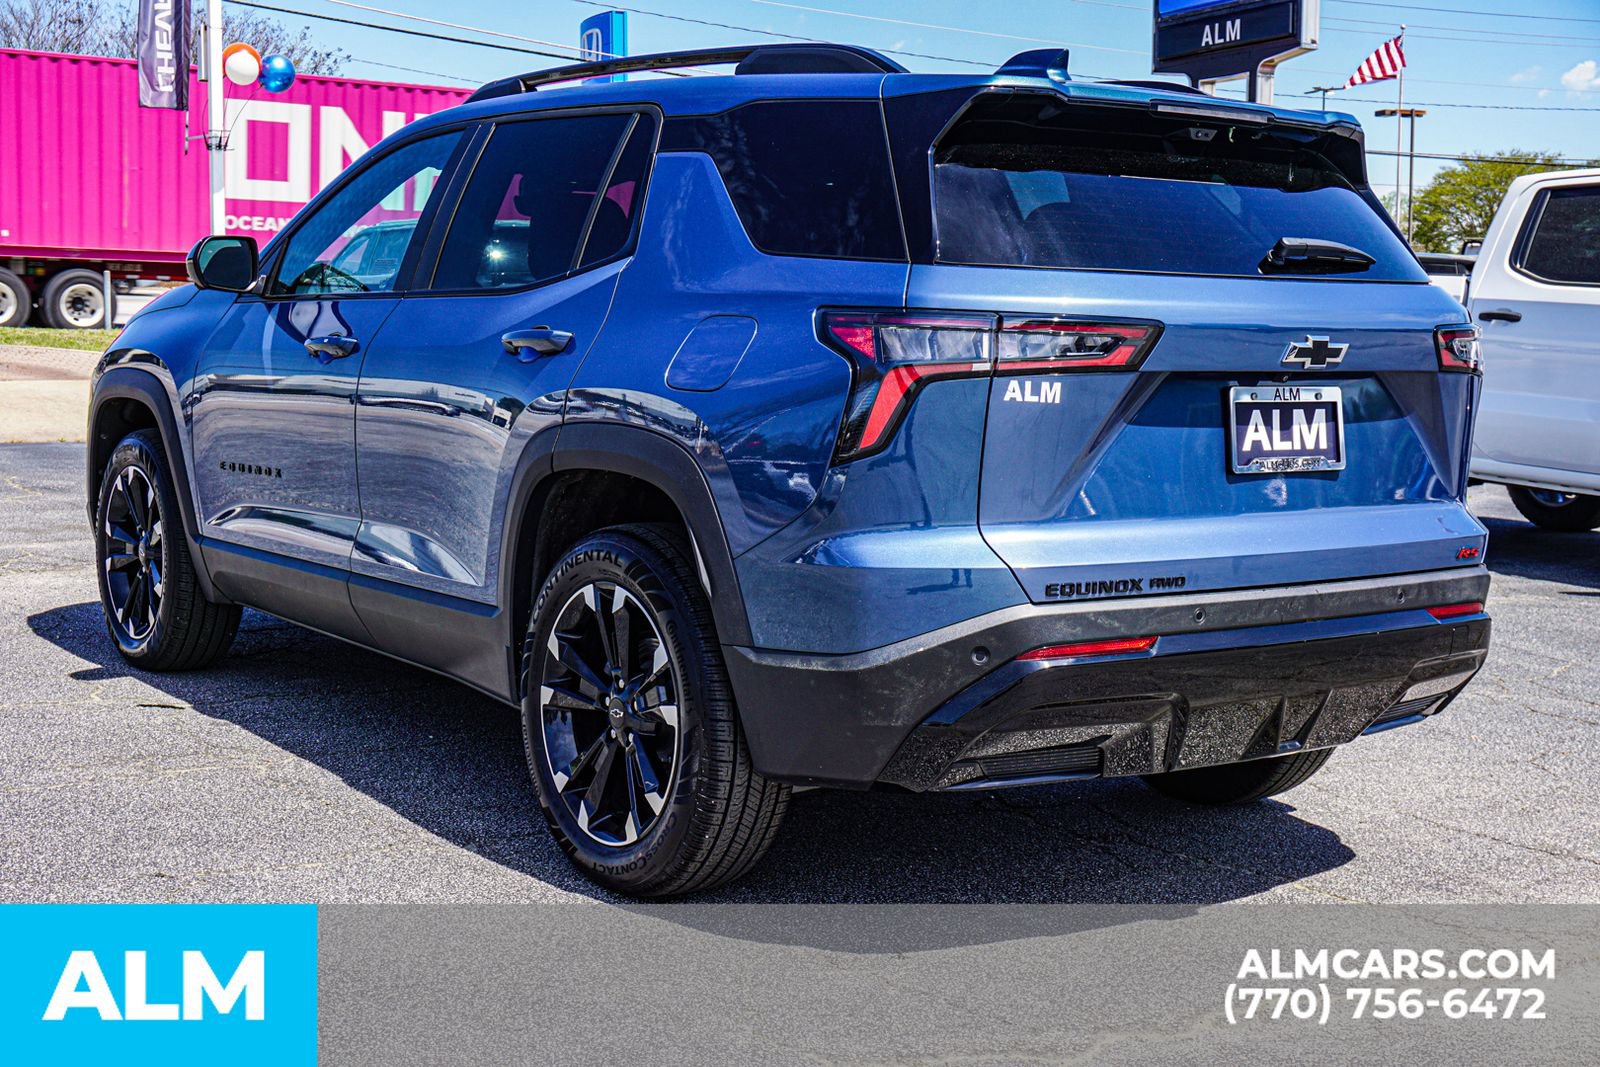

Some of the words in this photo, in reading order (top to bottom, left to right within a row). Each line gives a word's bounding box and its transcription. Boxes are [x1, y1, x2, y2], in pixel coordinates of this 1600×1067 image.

[1201, 18, 1241, 47] ALM
[1003, 379, 1062, 404] ALM
[1273, 387, 1301, 401] ALM
[1241, 408, 1328, 452] ALM
[531, 549, 624, 626] CONTINENTAL
[1044, 577, 1144, 598] EQUINOX
